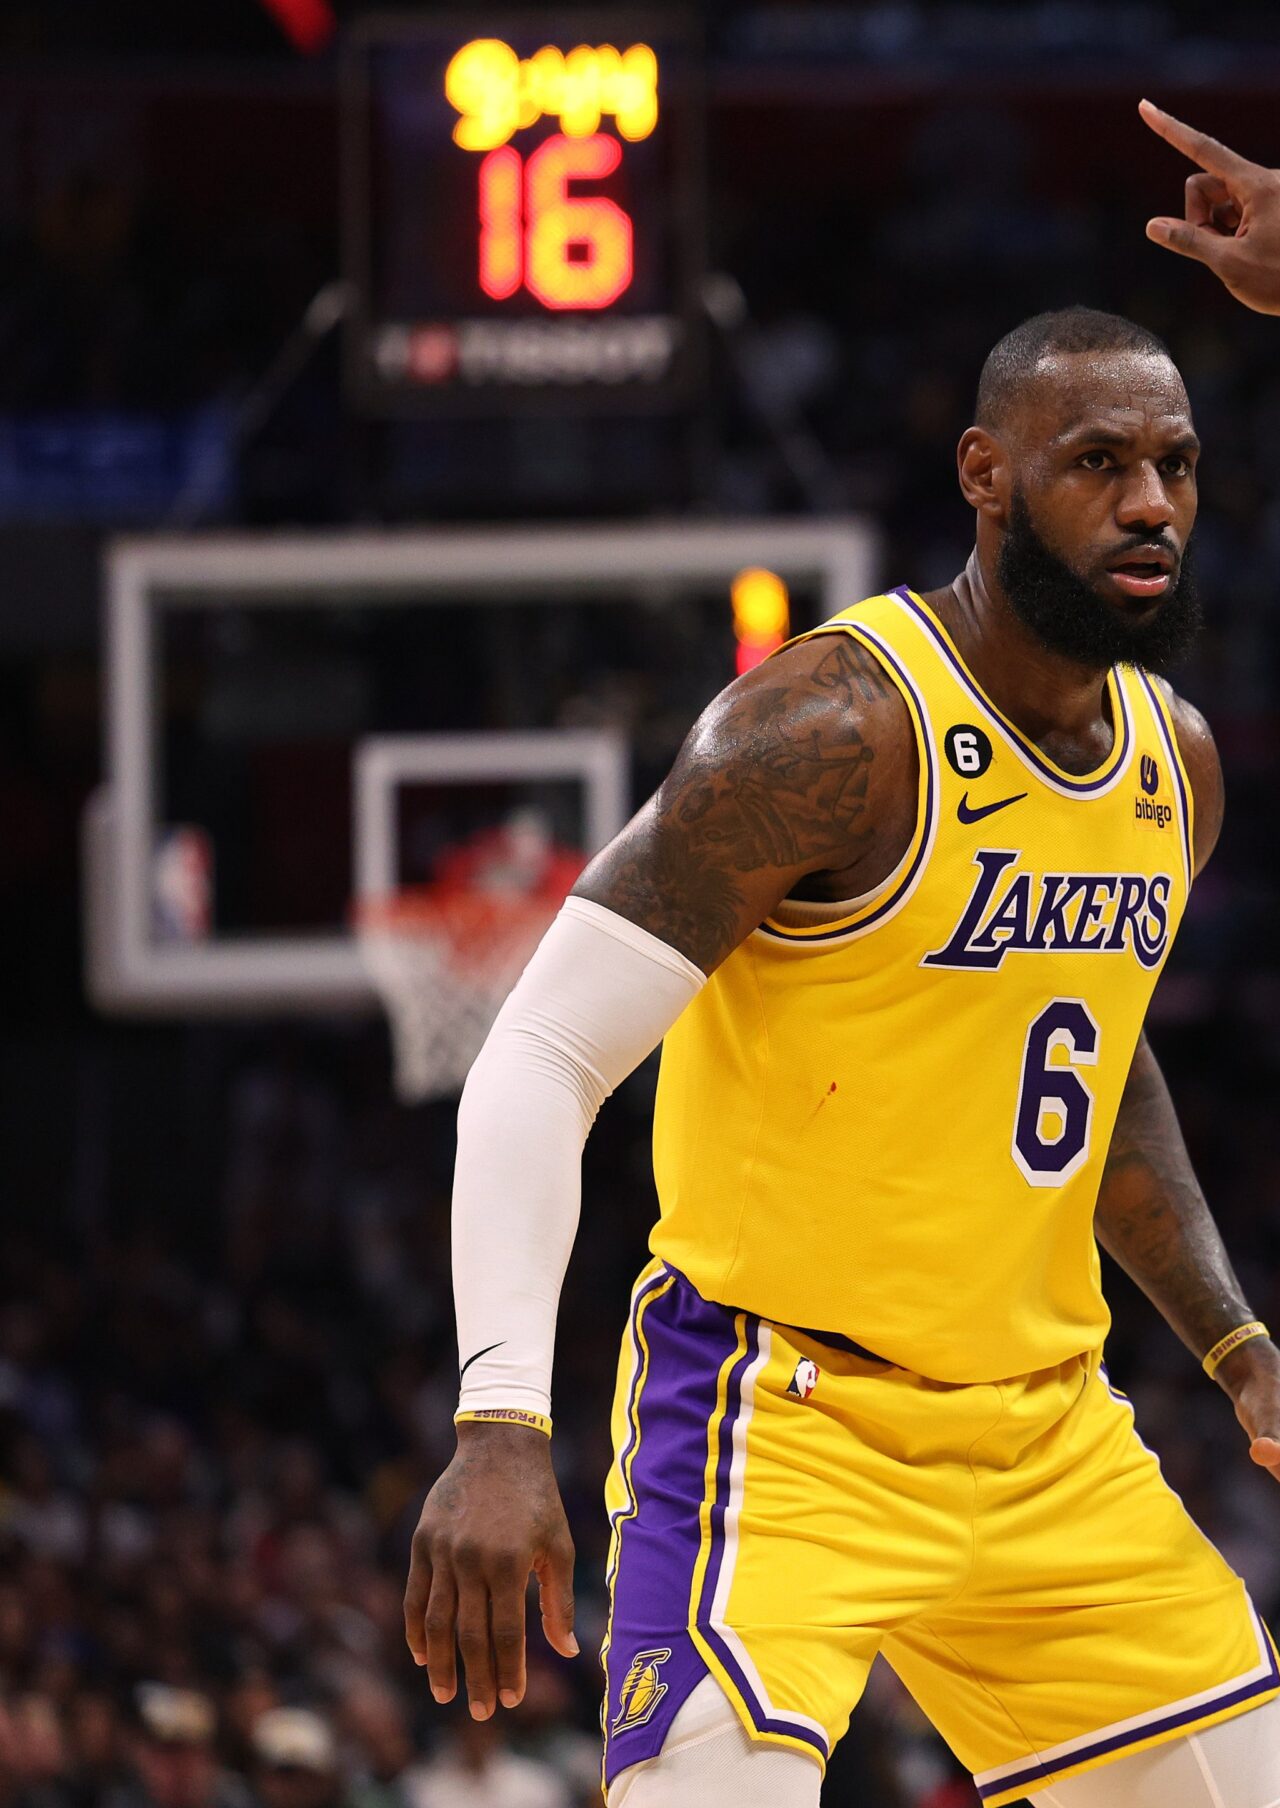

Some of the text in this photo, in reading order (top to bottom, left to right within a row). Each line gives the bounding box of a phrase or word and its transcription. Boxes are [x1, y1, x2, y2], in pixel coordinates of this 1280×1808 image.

[479, 133, 632, 309] 16
[953, 732, 980, 771] 6
[1135, 797, 1172, 828] bibigo
[920, 848, 1172, 972] LAKERS
[1011, 996, 1101, 1188] 6
